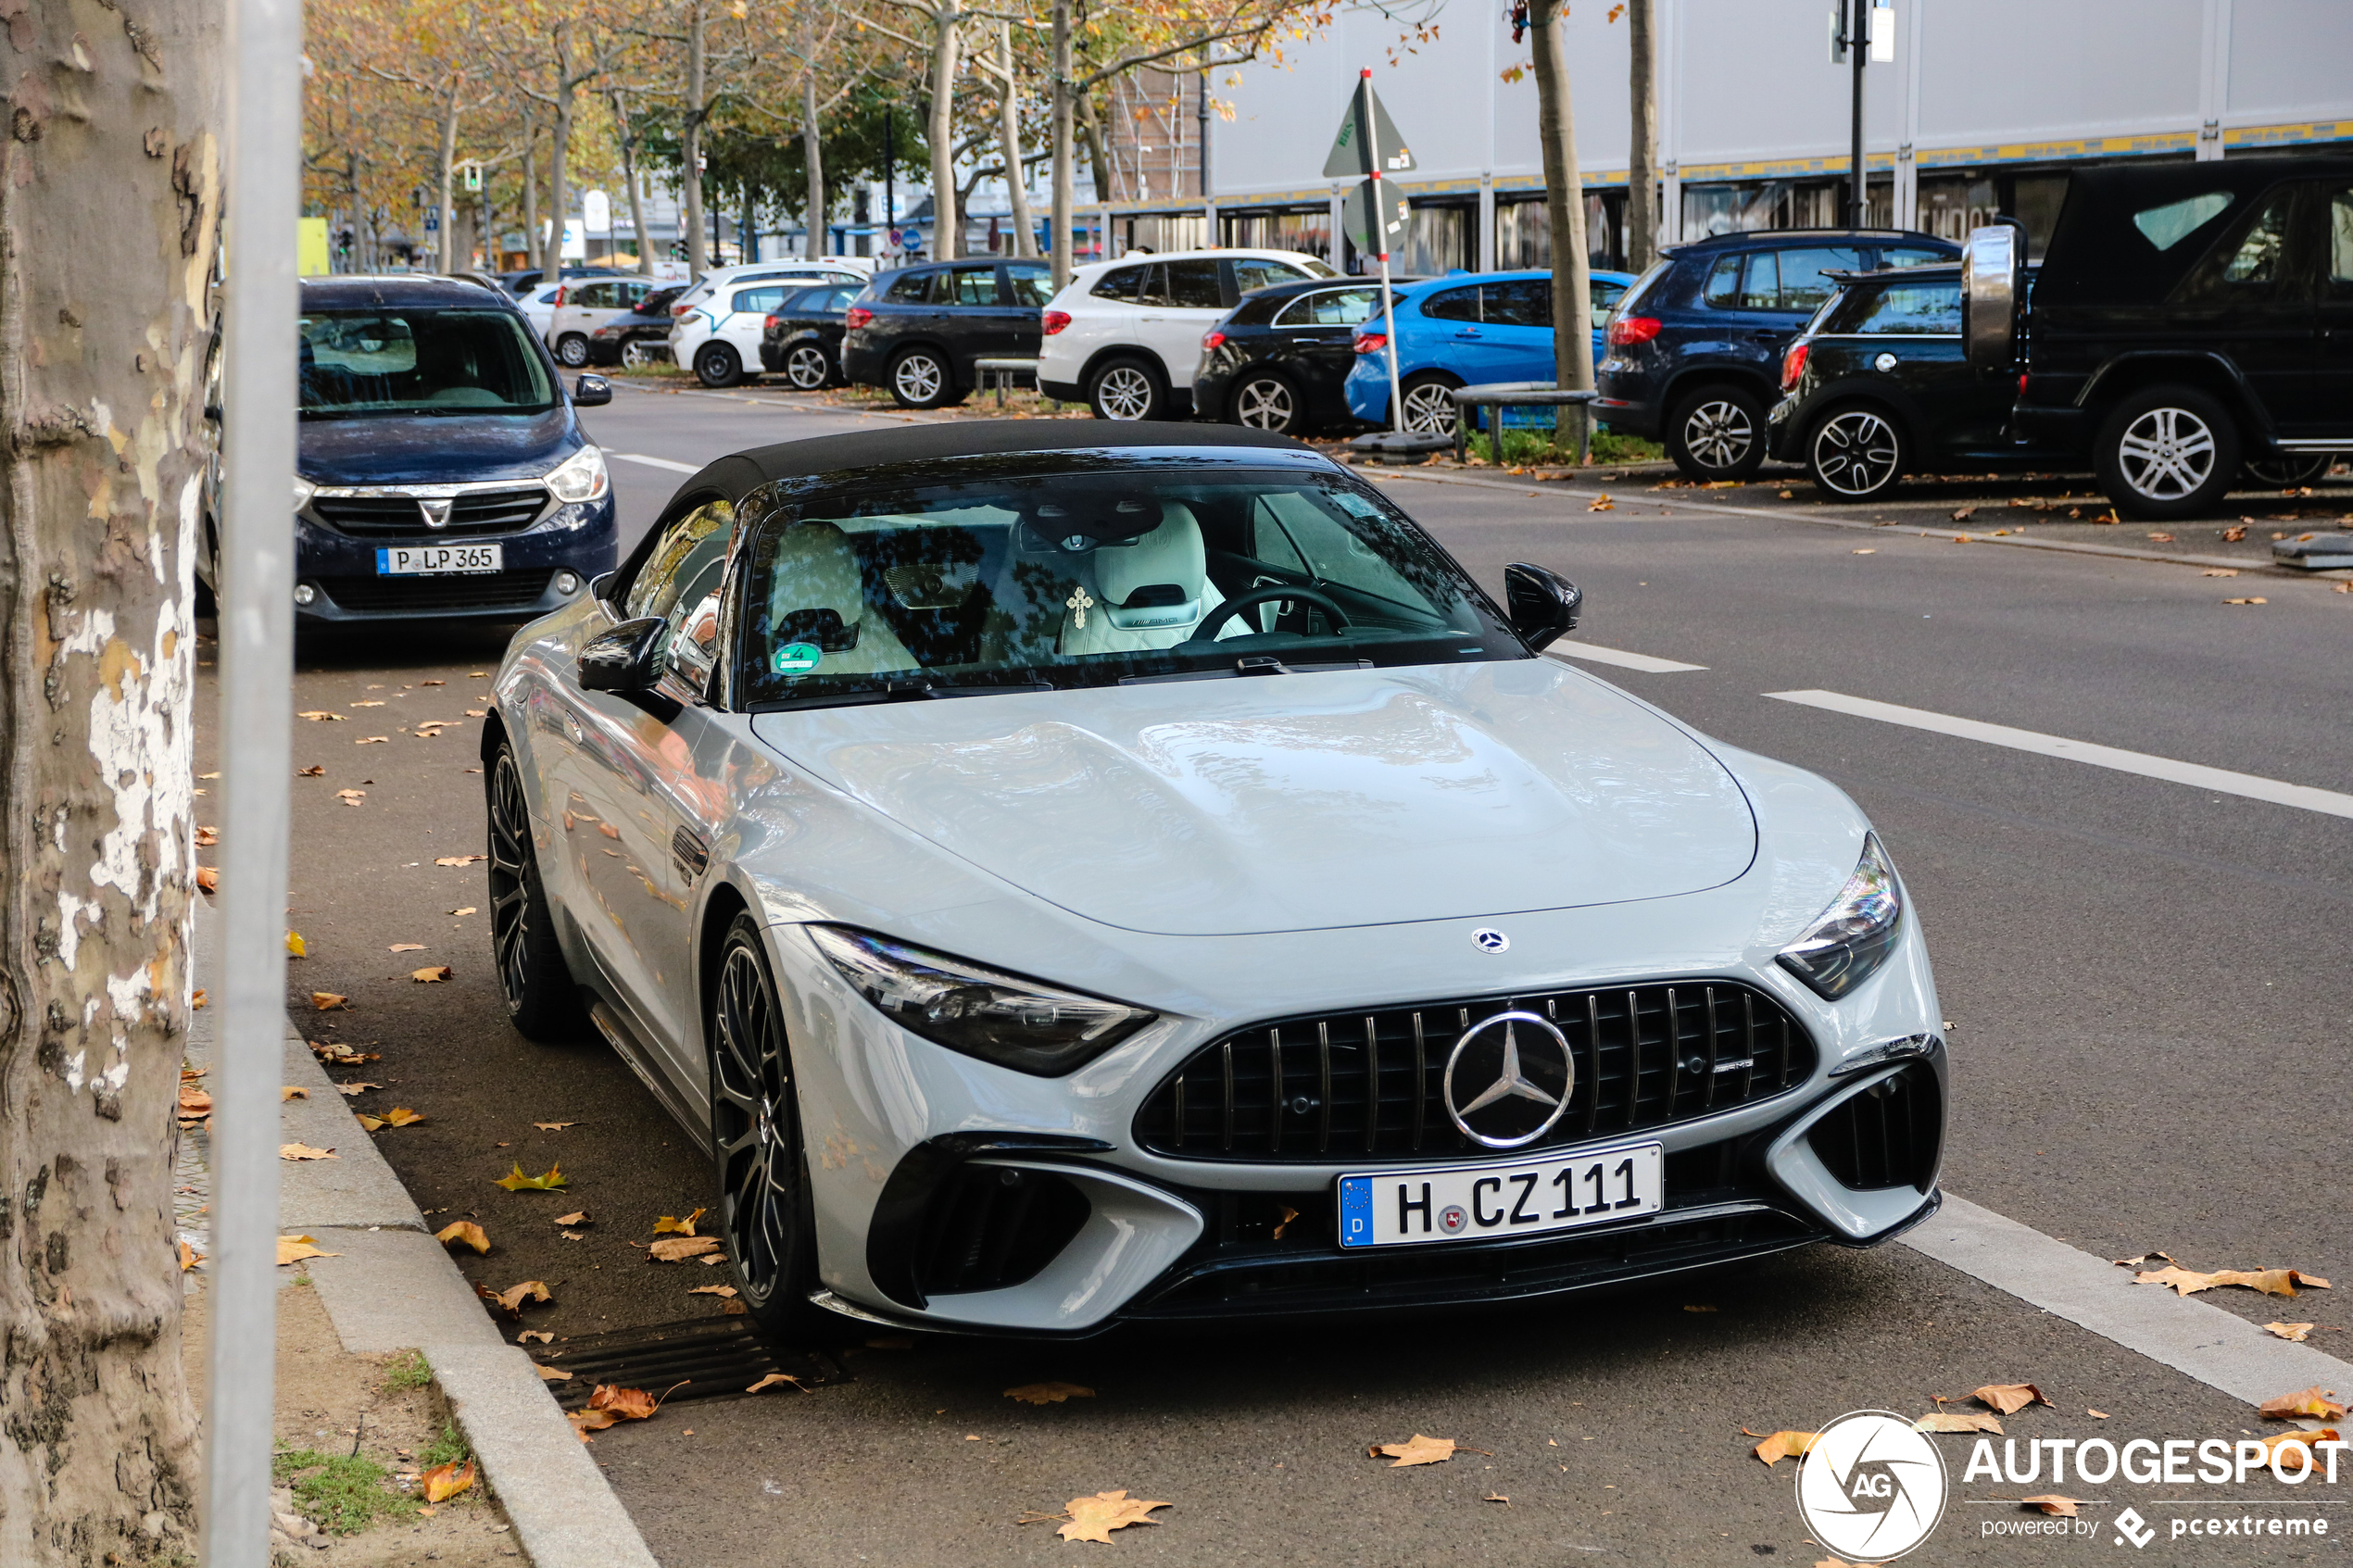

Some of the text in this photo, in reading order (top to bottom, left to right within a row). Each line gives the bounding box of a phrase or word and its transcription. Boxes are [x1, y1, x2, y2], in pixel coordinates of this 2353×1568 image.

[397, 548, 493, 570] P LP 365
[792, 647, 804, 659] 4
[1398, 1182, 1432, 1235] H
[1473, 1173, 1540, 1227] CZ
[1553, 1158, 1641, 1220] 111
[1352, 1218, 1364, 1234] D
